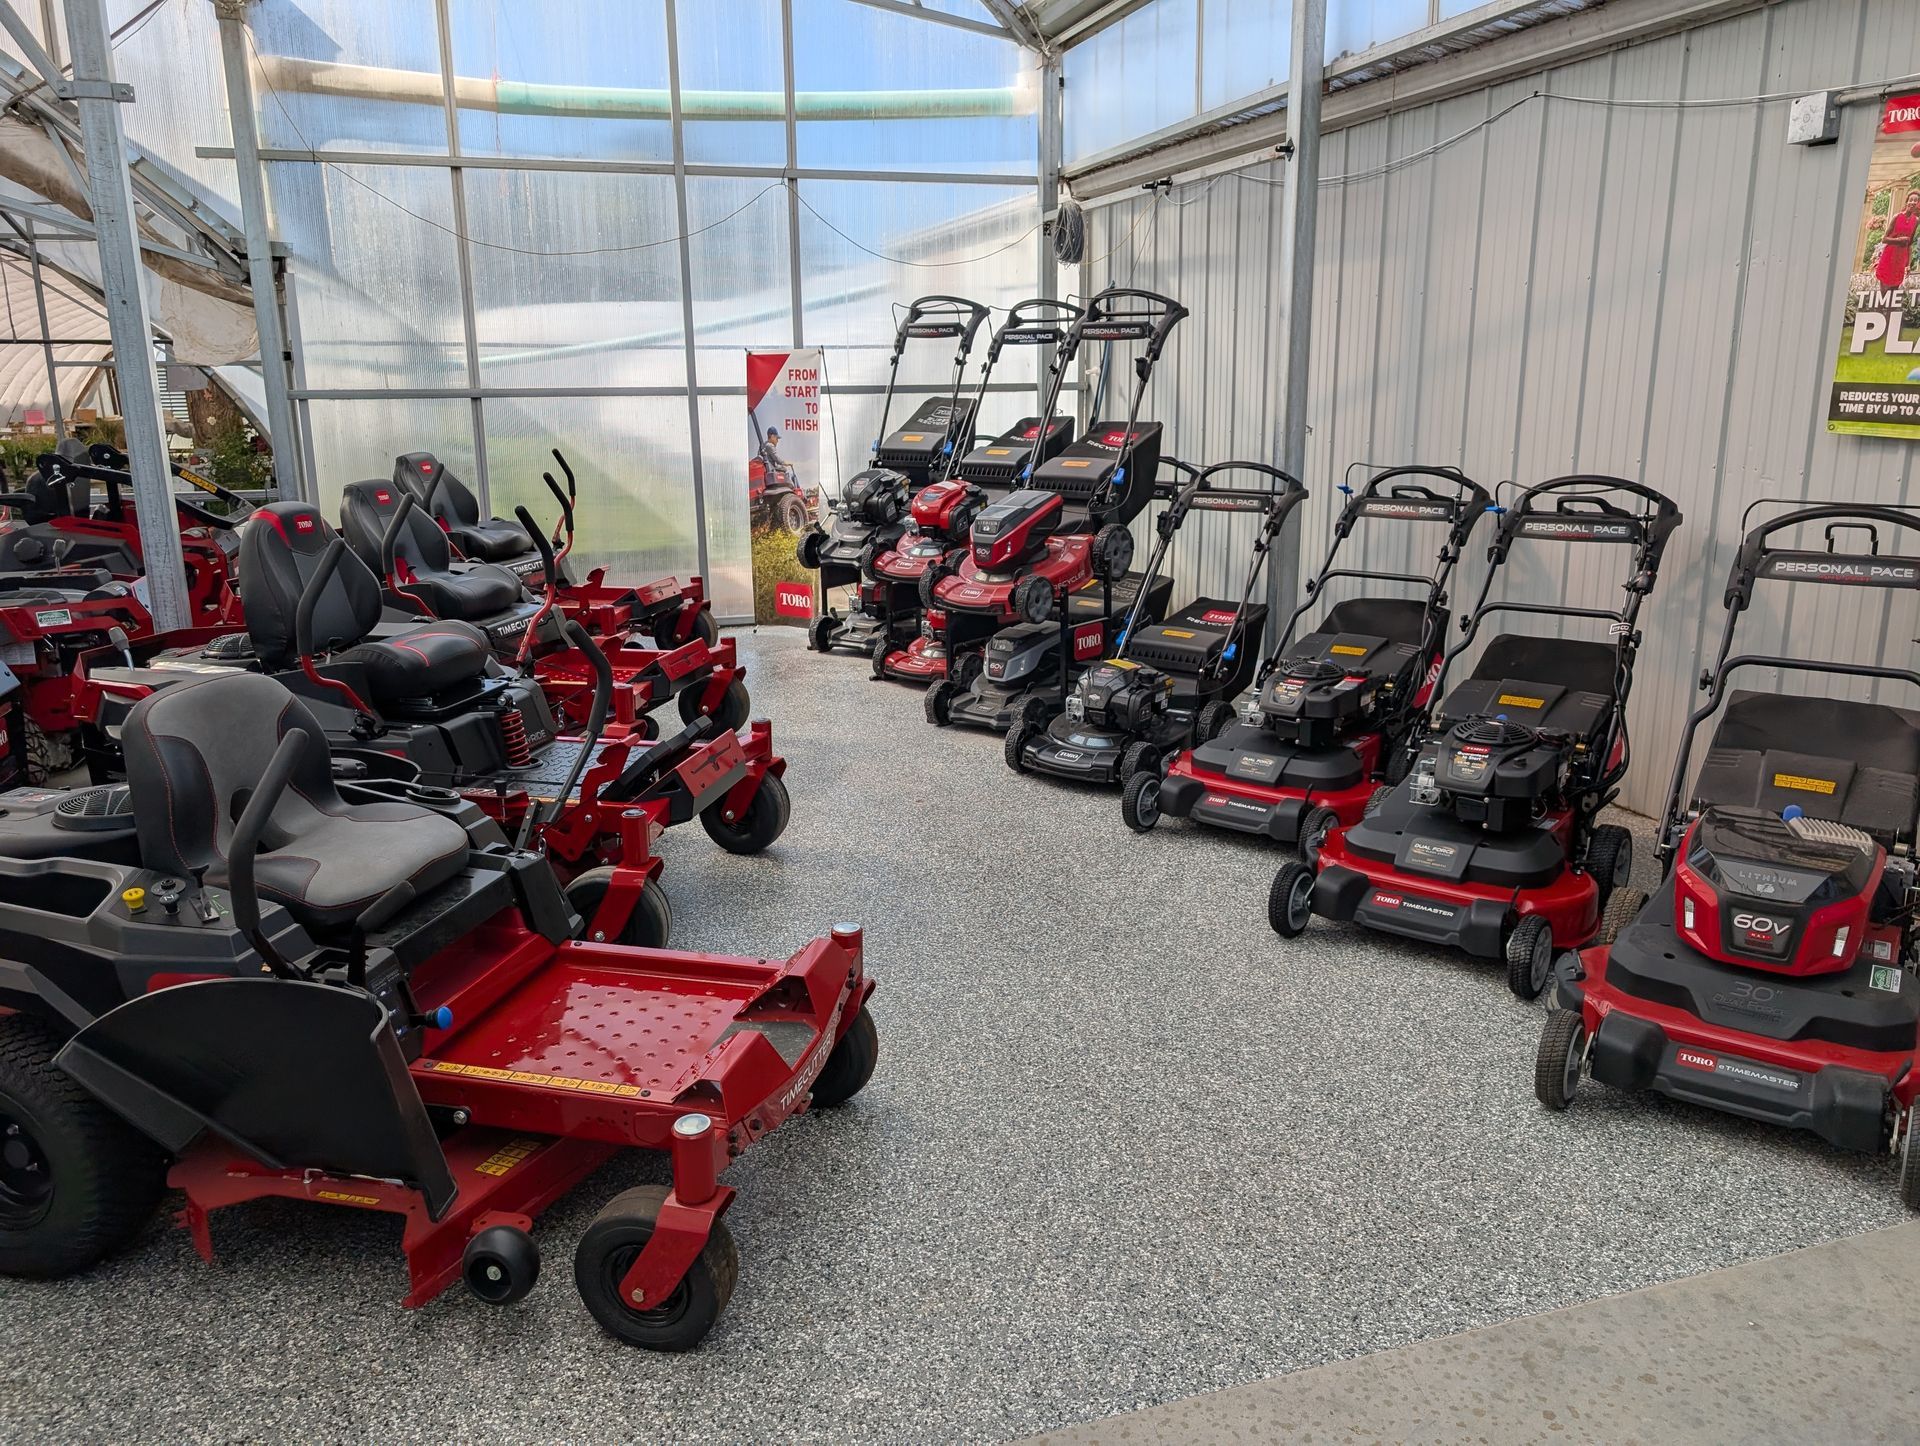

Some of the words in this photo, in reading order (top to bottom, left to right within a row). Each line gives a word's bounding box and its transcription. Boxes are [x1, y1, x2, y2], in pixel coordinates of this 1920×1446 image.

[1856, 290, 1903, 308] TIME
[1850, 311, 1920, 354] PL
[788, 368, 817, 381] FROM
[785, 385, 818, 398] START
[1840, 391, 1889, 403] REDUCES
[1891, 392, 1920, 404] YOUR
[805, 402, 818, 415] TO
[1839, 403, 1864, 414] TIME
[1866, 404, 1881, 414] BY
[1882, 405, 1898, 415] UP
[1900, 405, 1914, 416] TO
[785, 419, 818, 431] FINISH
[1193, 497, 1235, 505] PERSONAL
[1236, 499, 1259, 507] PACE
[1366, 503, 1416, 513] PERSONAL
[1419, 506, 1445, 515] PACE
[296, 520, 313, 529] TORO
[1524, 522, 1589, 533] PERSONAL
[1593, 525, 1627, 535] PACE
[513, 561, 543, 574] TIMECUTT
[1775, 561, 1864, 576] PERSONAL
[1871, 566, 1915, 578] PACE
[780, 593, 811, 609] TORO
[1076, 633, 1102, 651] TORO
[1208, 796, 1227, 804] TORO
[1228, 801, 1268, 813] TIMEMASTER
[1432, 846, 1455, 855] FORCE
[1739, 870, 1798, 887] LITHIUM
[1376, 895, 1399, 905] TORO
[1402, 901, 1454, 917] TIMEMASTER
[780, 1033, 832, 1111] TIMECUTTER
[1680, 1053, 1715, 1067] TORO
[1718, 1064, 1800, 1089] eTIMEMASTER
